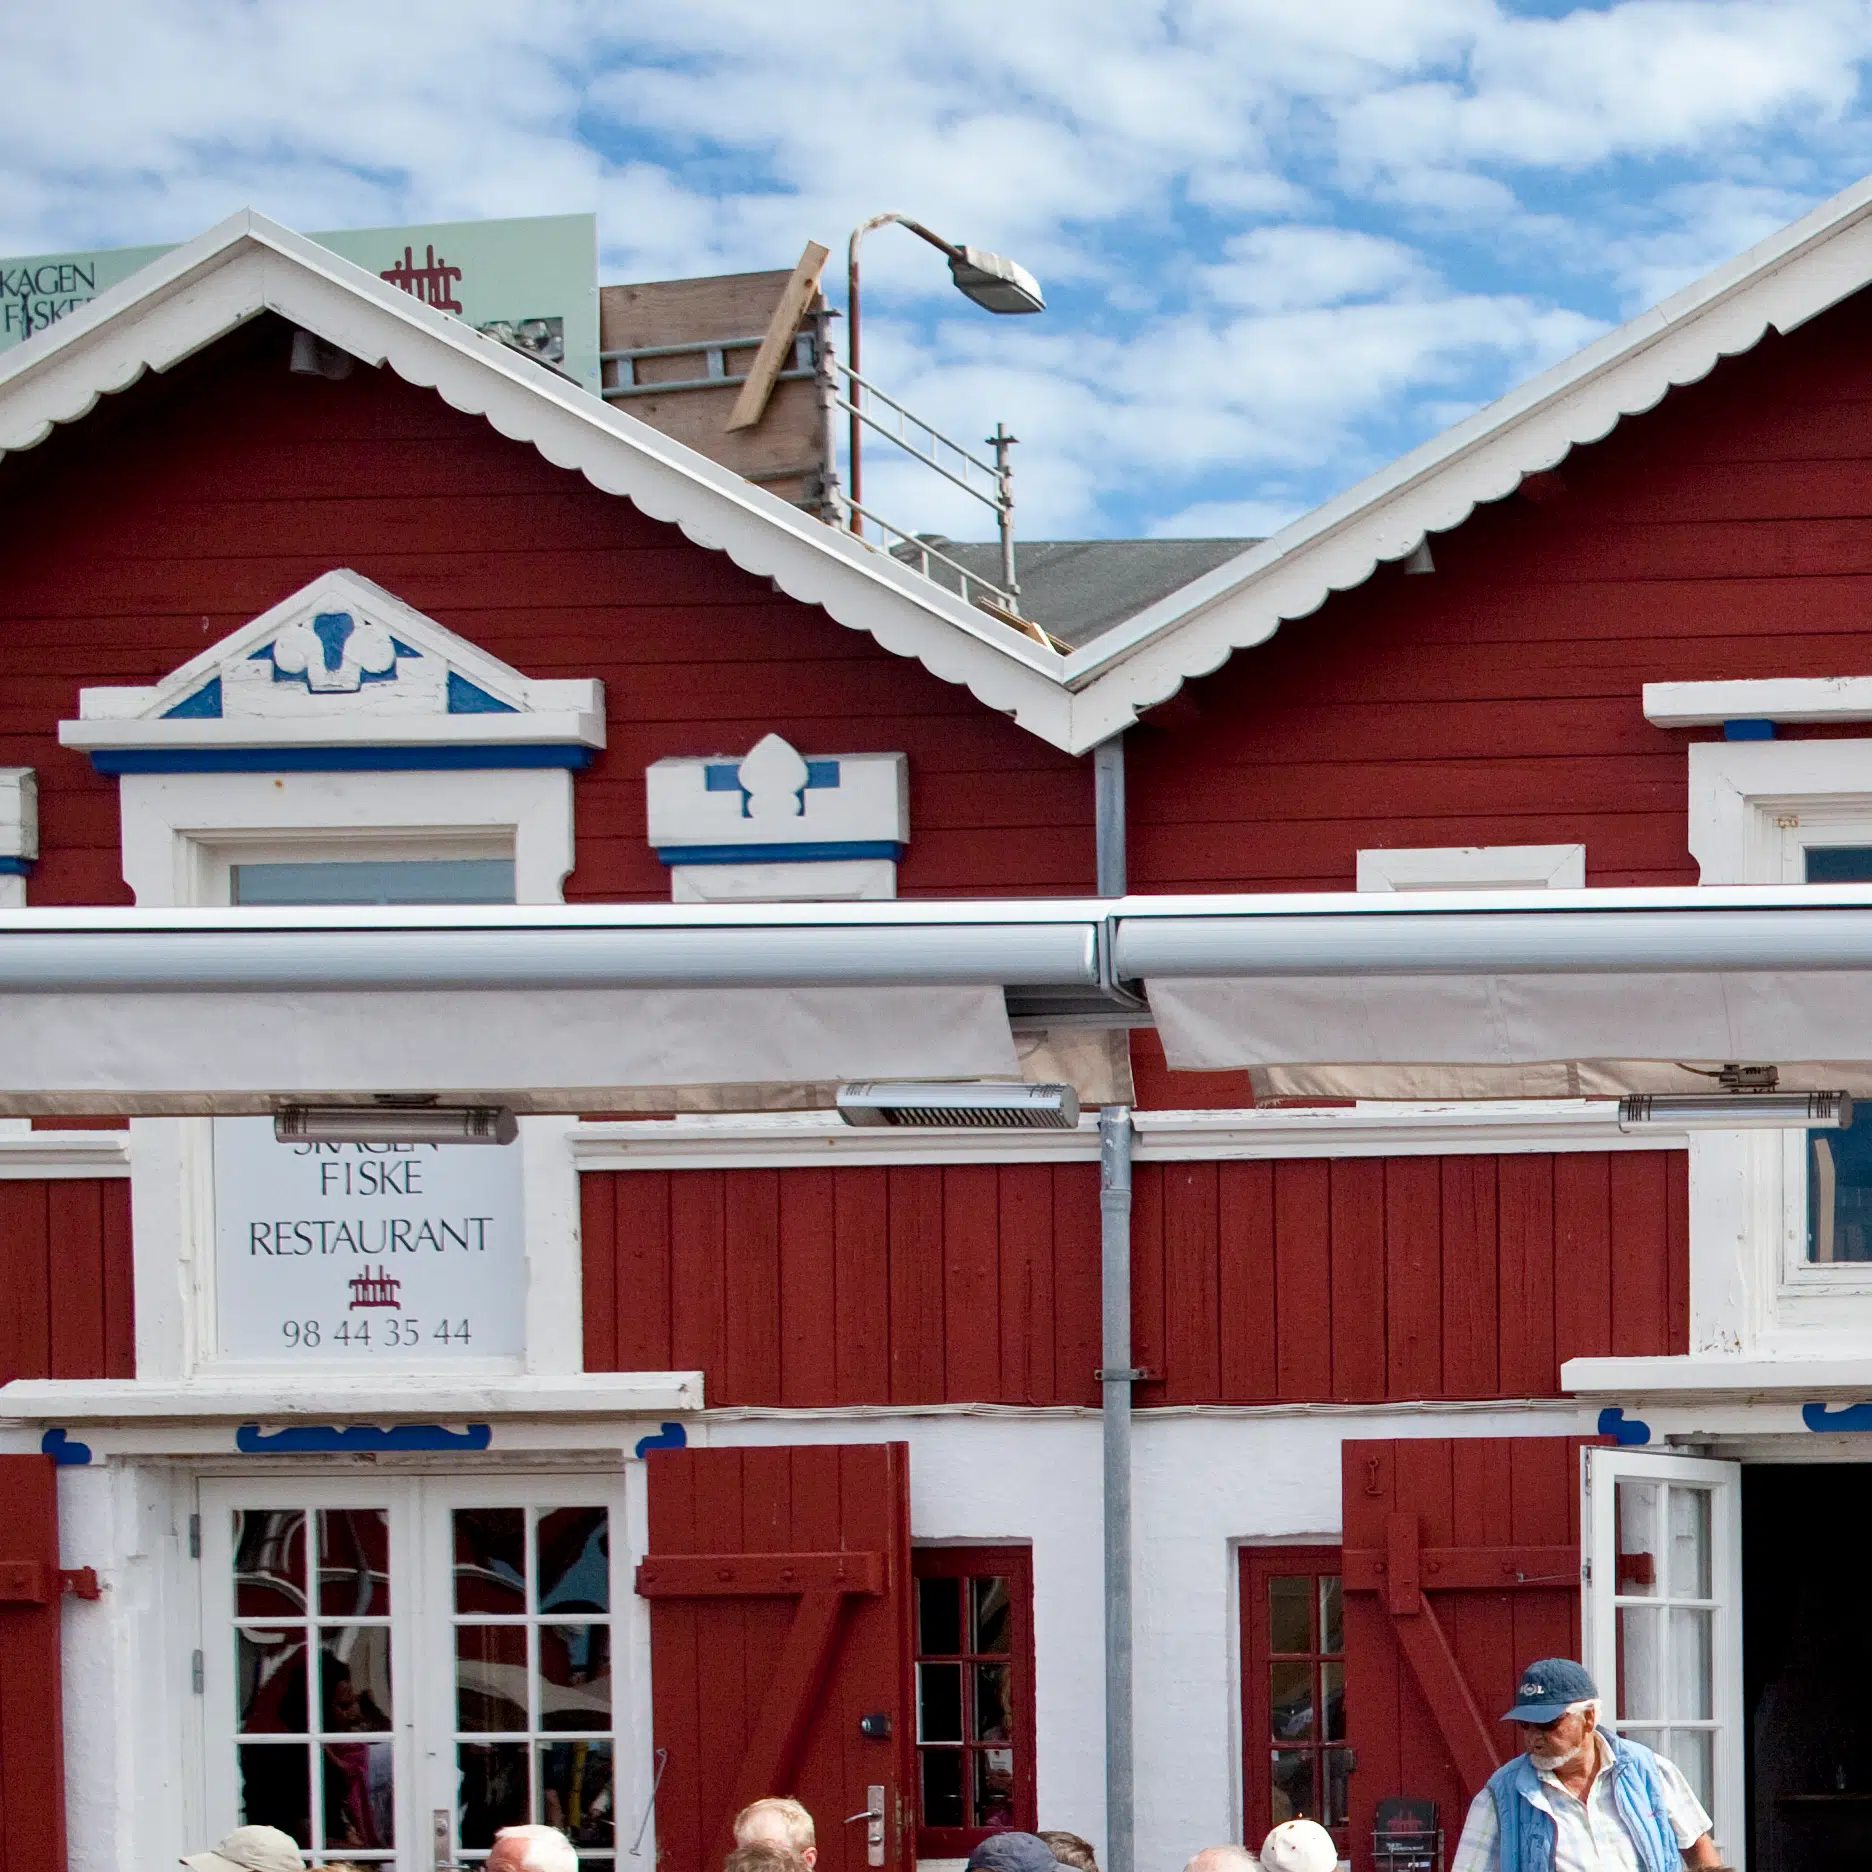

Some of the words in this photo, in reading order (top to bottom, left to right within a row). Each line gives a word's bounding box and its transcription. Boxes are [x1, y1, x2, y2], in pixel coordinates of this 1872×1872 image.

[0, 262, 95, 297] KAGEN
[320, 1159, 423, 1197] FISKE
[250, 1217, 493, 1256] RESTAURANT
[282, 1320, 321, 1348] 98
[333, 1320, 372, 1346] 44
[386, 1319, 420, 1346] 35
[433, 1318, 473, 1345] 44
